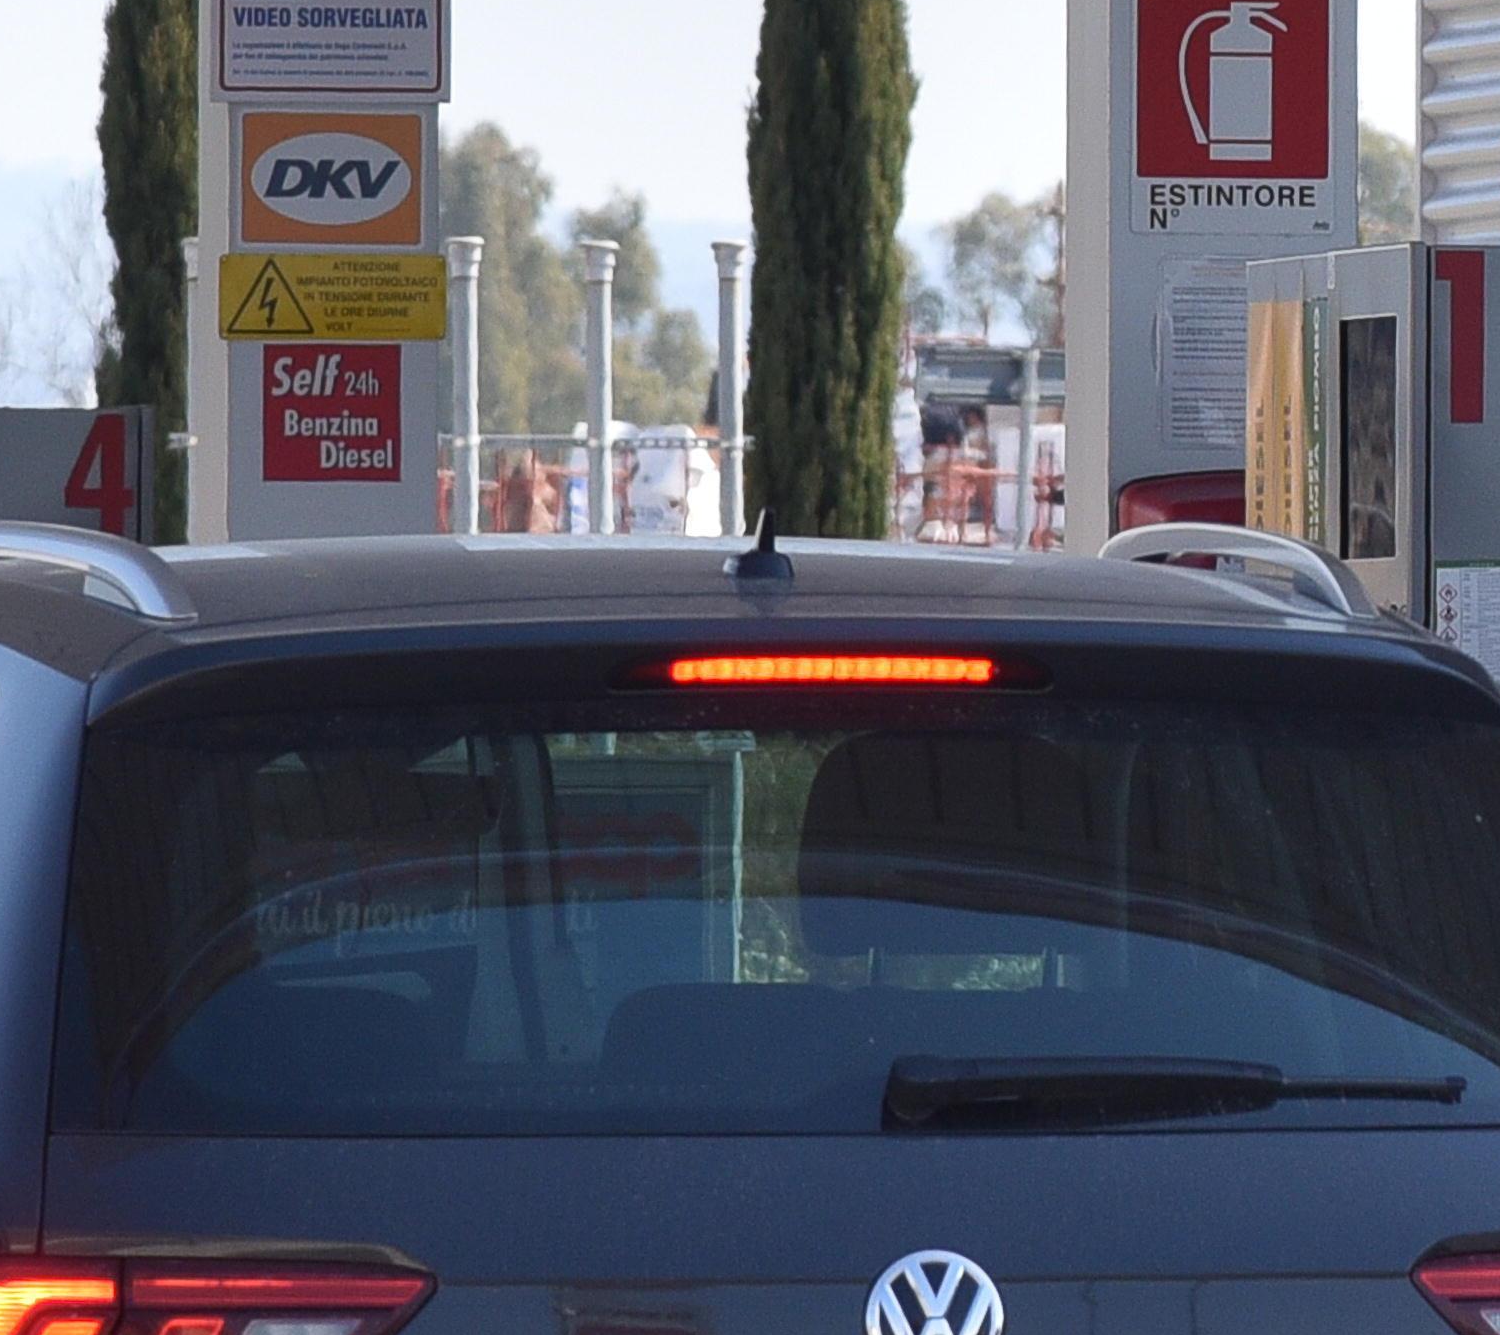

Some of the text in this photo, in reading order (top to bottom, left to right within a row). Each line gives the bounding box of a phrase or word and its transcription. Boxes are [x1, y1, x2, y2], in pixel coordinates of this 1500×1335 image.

[233, 7, 428, 29] VIDEO SORVEGLIATA
[264, 159, 400, 199] DKV
[1150, 184, 1315, 207] ESTINTORE
[333, 262, 400, 272] ATTENZIONE
[1435, 250, 1484, 423] 1
[271, 354, 379, 396] Self 24h
[284, 410, 378, 436] Benzina
[320, 439, 394, 469] Diesel
[65, 413, 134, 535] 4
